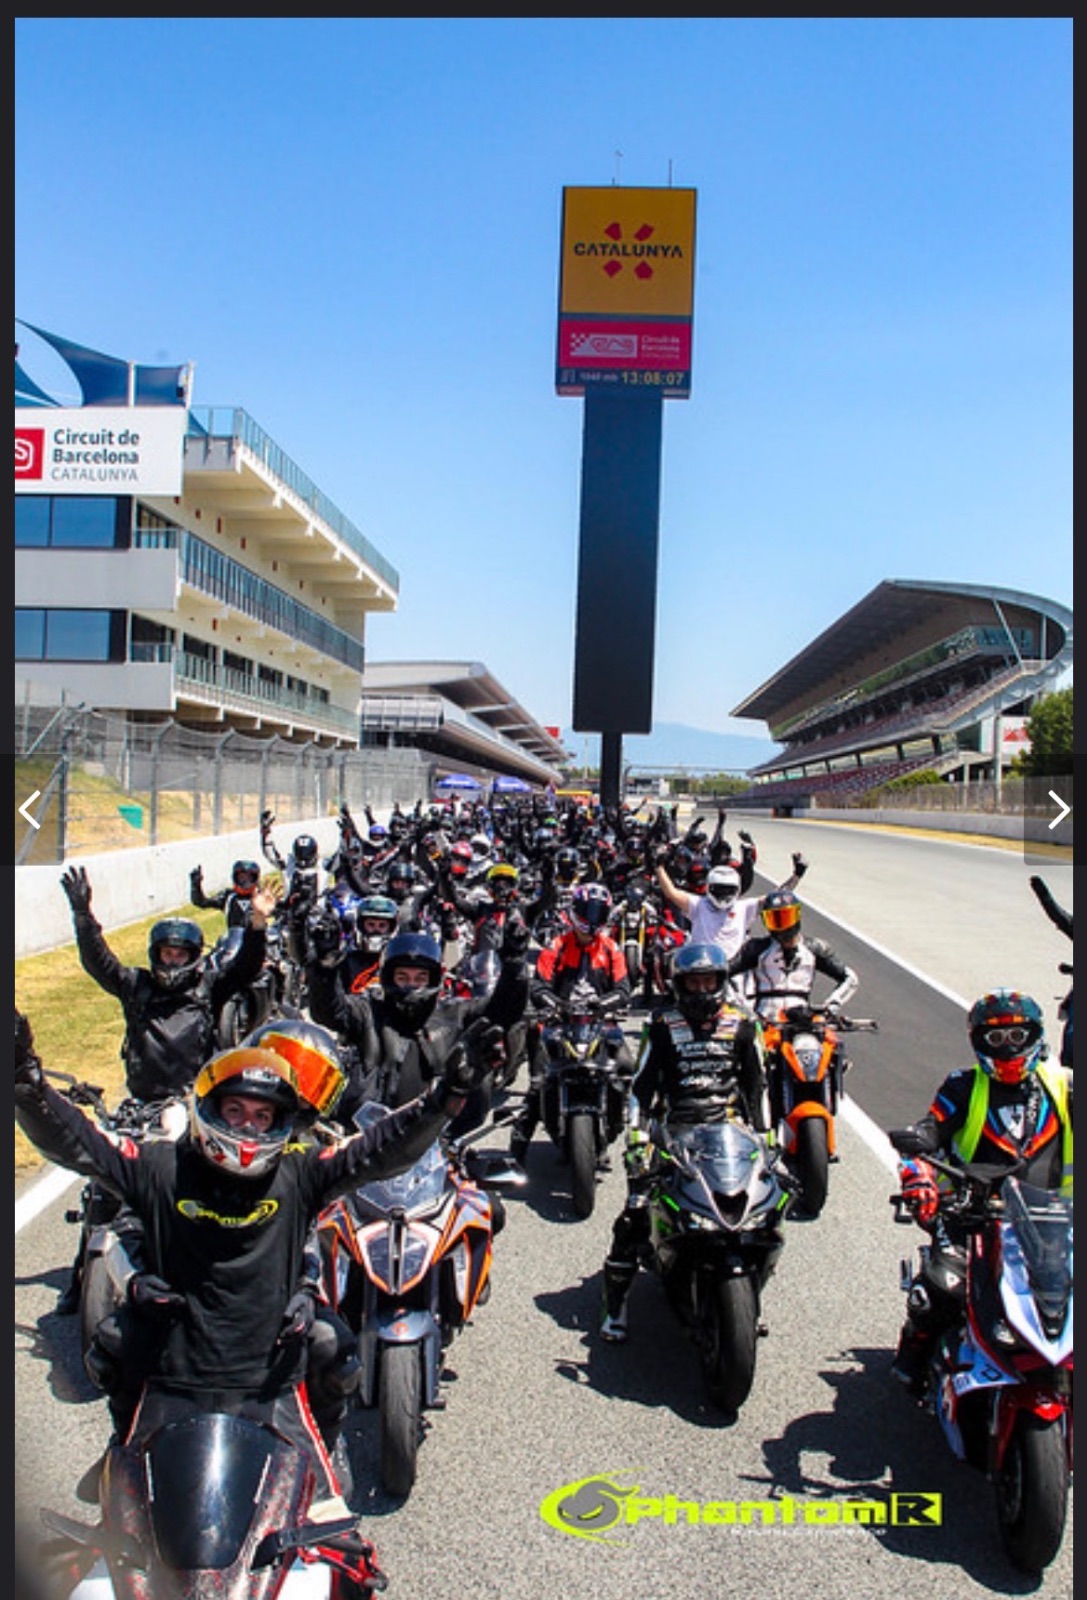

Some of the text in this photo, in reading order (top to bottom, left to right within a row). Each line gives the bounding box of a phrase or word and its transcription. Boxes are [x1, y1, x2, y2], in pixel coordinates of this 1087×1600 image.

[573, 242, 683, 258] CATALUNYA
[53, 428, 140, 445] Circuit de
[52, 448, 139, 465] Barcelona
[51, 467, 138, 482] CATALUNYA
